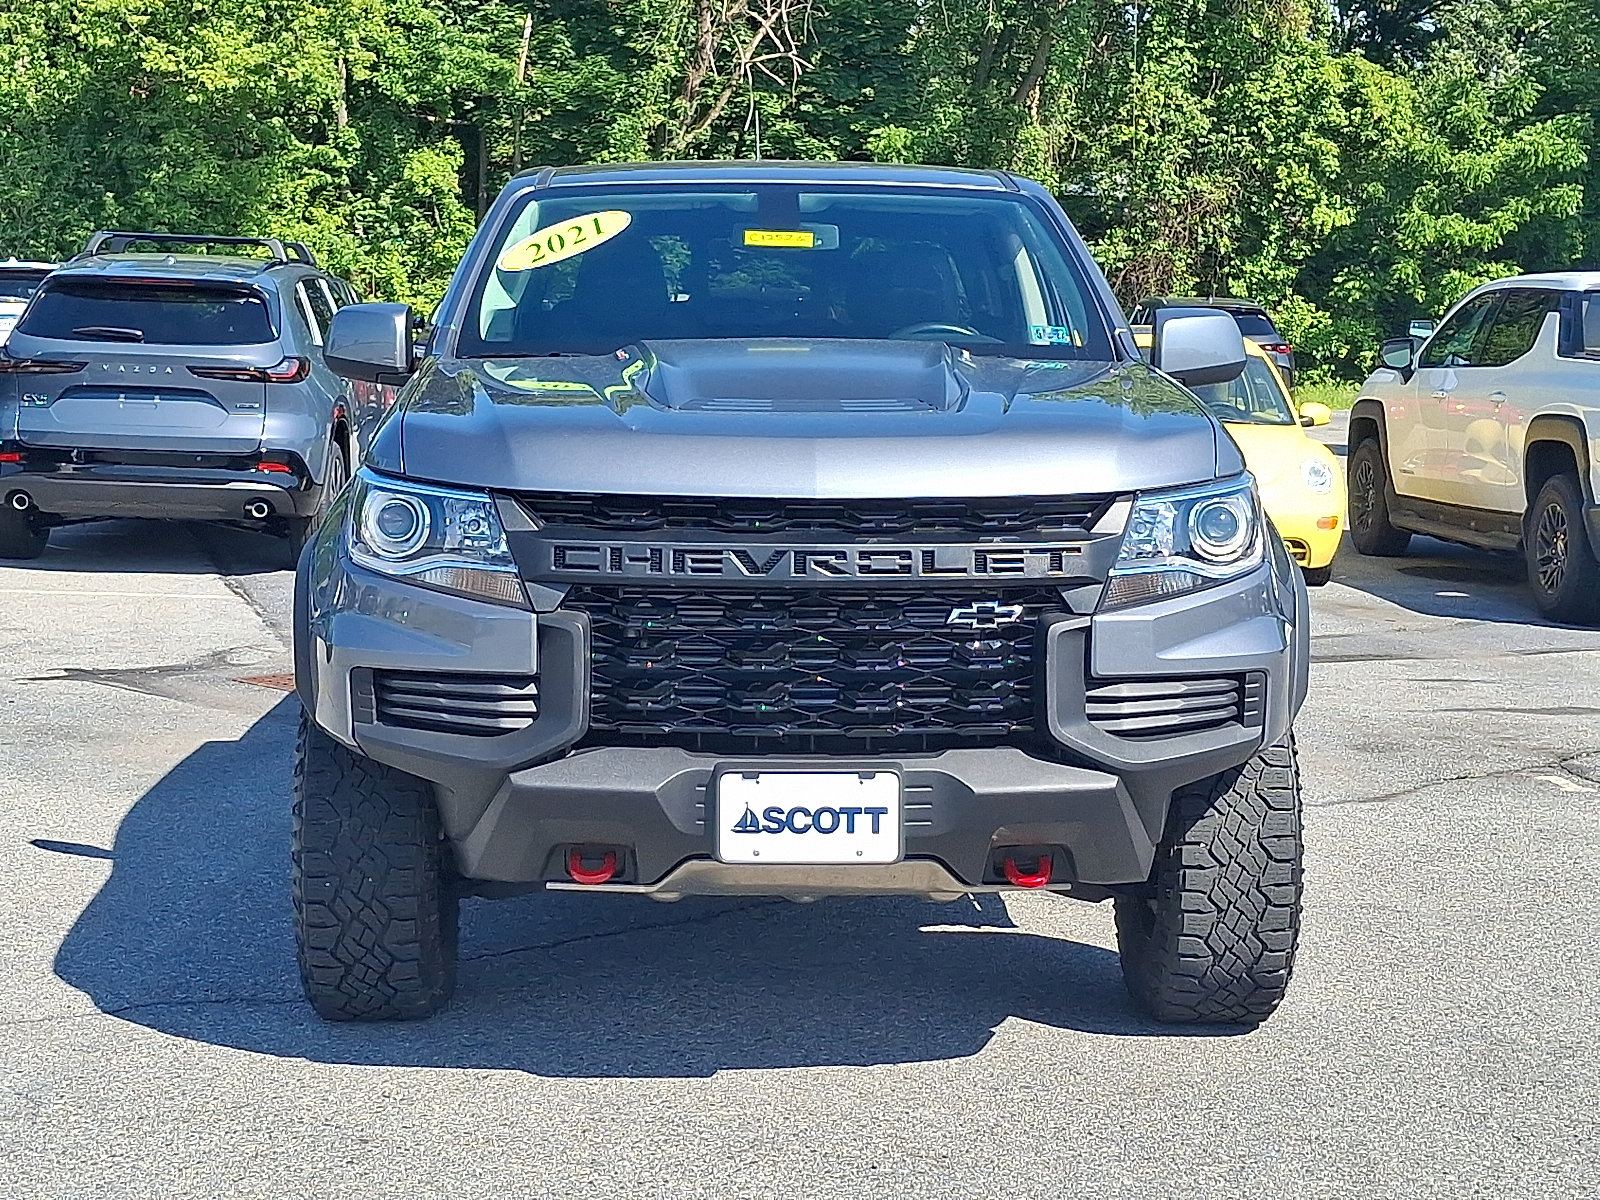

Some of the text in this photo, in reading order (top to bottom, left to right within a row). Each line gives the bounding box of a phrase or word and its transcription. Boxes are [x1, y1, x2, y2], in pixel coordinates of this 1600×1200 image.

[525, 217, 605, 264] 2021
[101, 363, 173, 374] MAZDA
[551, 544, 1083, 577] CHEVROLET
[761, 805, 889, 835] SCOTT
